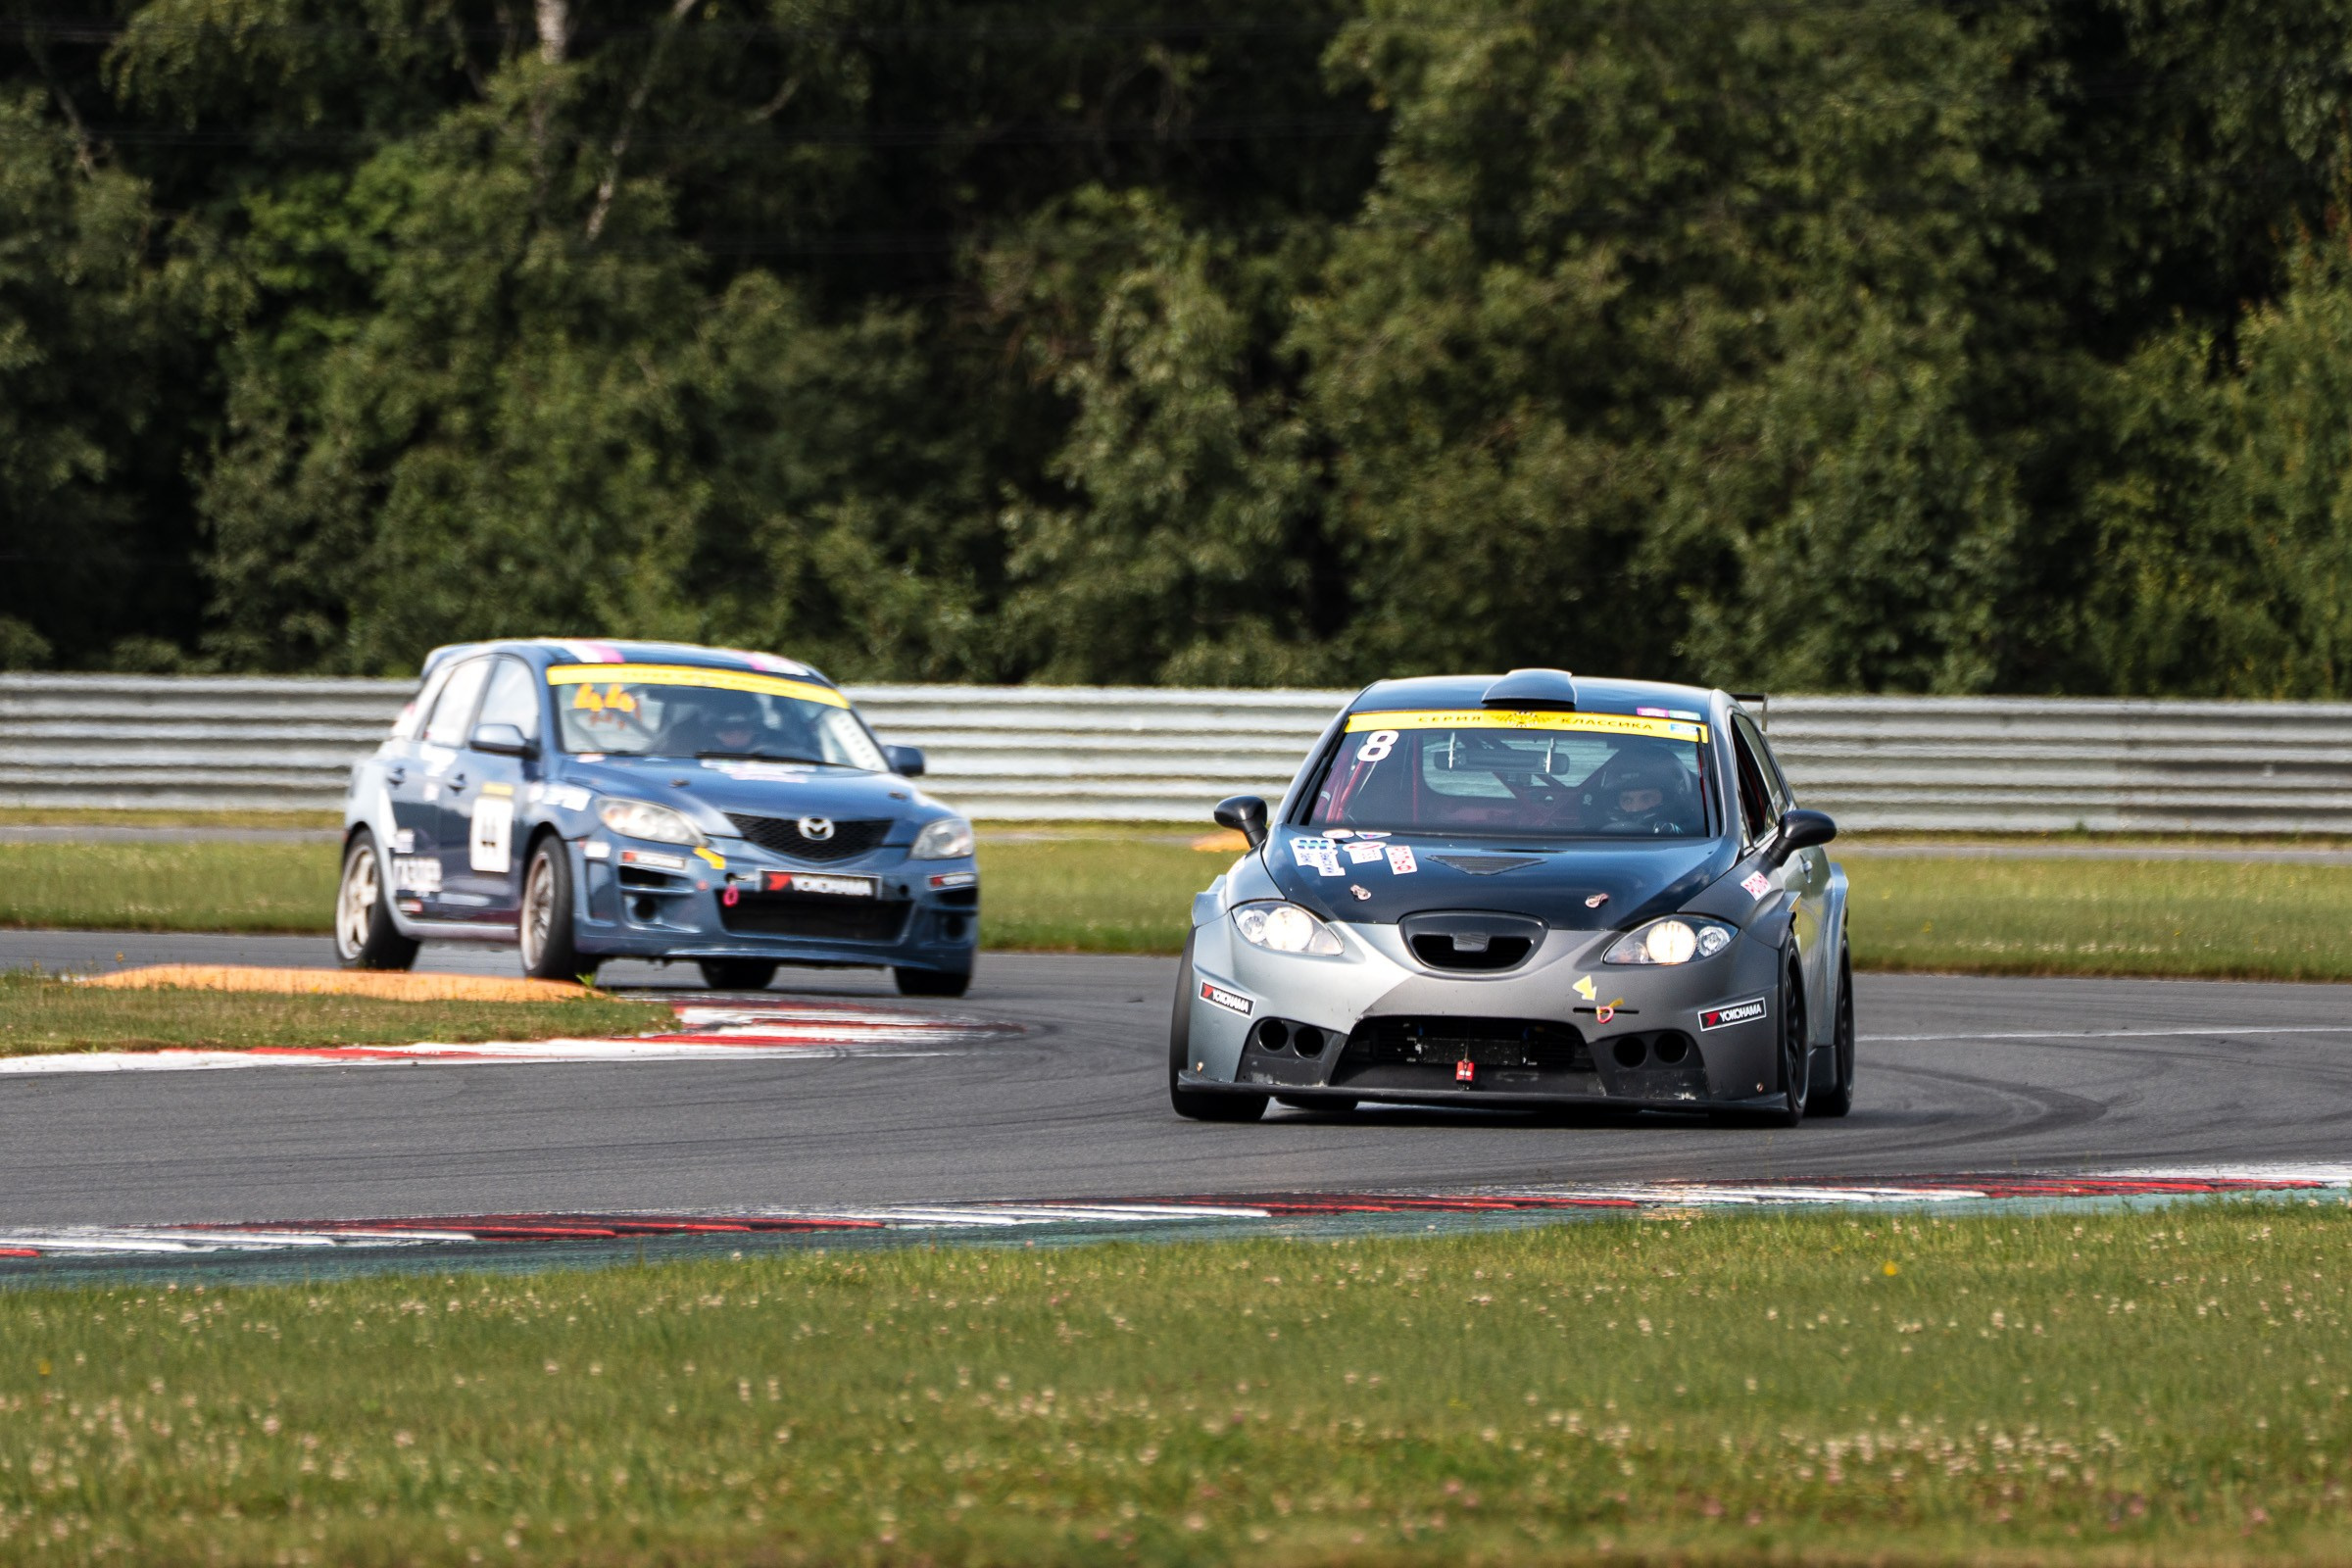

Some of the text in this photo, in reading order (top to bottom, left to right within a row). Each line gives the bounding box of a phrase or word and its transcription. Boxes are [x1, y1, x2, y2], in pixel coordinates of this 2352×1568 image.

[572, 682, 636, 711] 44
[1418, 714, 1653, 730] СЕРИЯ КЛАССИКА
[1356, 729, 1399, 761] 8
[1212, 988, 1250, 1013] YOKOHAMA
[1719, 1003, 1762, 1023] YOKOHAMA
